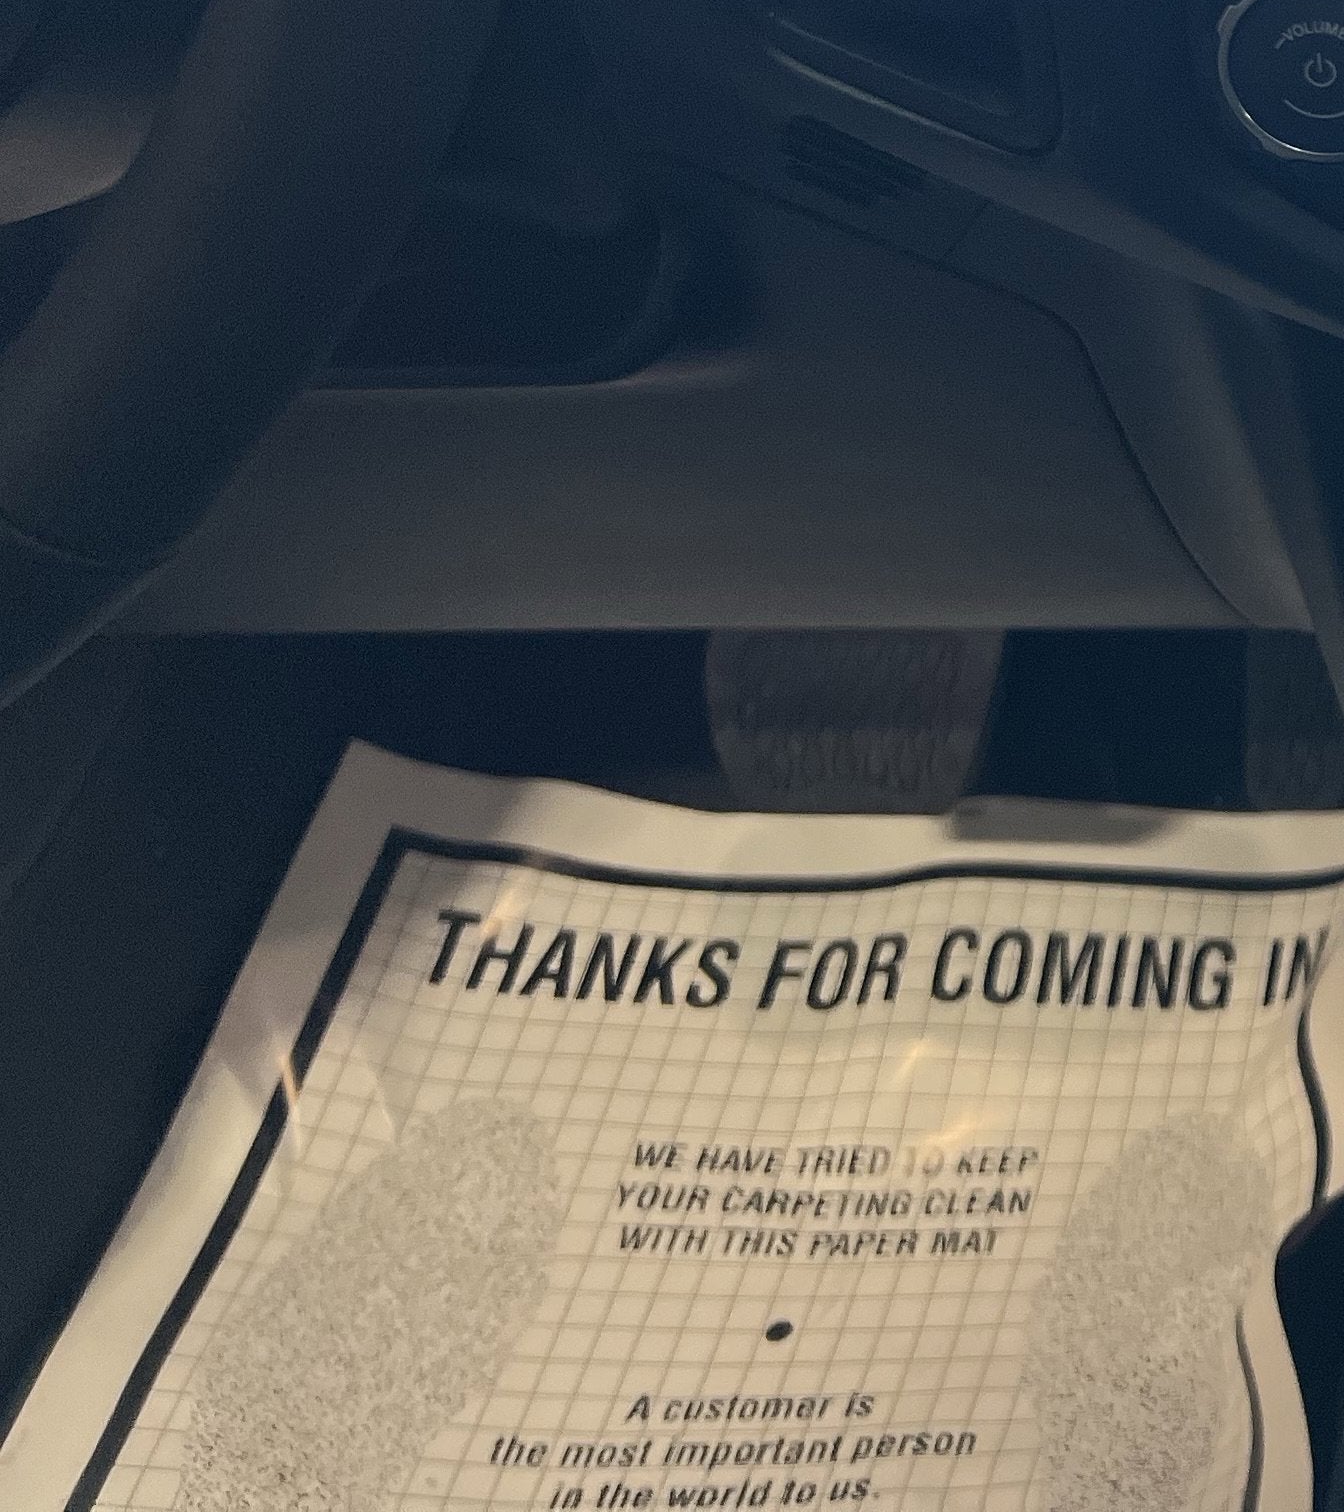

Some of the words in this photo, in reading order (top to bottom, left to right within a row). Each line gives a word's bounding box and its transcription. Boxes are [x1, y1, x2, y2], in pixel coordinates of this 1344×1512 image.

[424, 908, 740, 1010] THANKS
[758, 935, 910, 1010] FOR
[928, 926, 1236, 1010] COMING
[634, 1141, 680, 1171] WE
[696, 1146, 778, 1175] HAVE
[797, 1147, 891, 1177] TRIED
[903, 1149, 945, 1177] TO
[957, 1146, 1040, 1177] KEEP
[615, 1184, 709, 1214] YOUR
[722, 1185, 910, 1218] CARPETING
[924, 1188, 1033, 1217] CLEAN
[619, 1226, 709, 1254] WITH
[723, 1228, 797, 1256] THIS
[809, 1231, 918, 1258] PAPER
[930, 1228, 999, 1256] MAT
[625, 1394, 651, 1422] A
[663, 1392, 831, 1423] customer
[845, 1392, 874, 1419] is
[489, 1436, 548, 1469] the
[560, 1439, 653, 1469] most
[664, 1434, 841, 1470] important
[851, 1429, 977, 1462] person
[550, 1481, 582, 1510] in
[600, 1481, 652, 1510] the
[668, 1472, 769, 1509] world
[782, 1476, 816, 1506] to
[829, 1476, 880, 1503] us.
